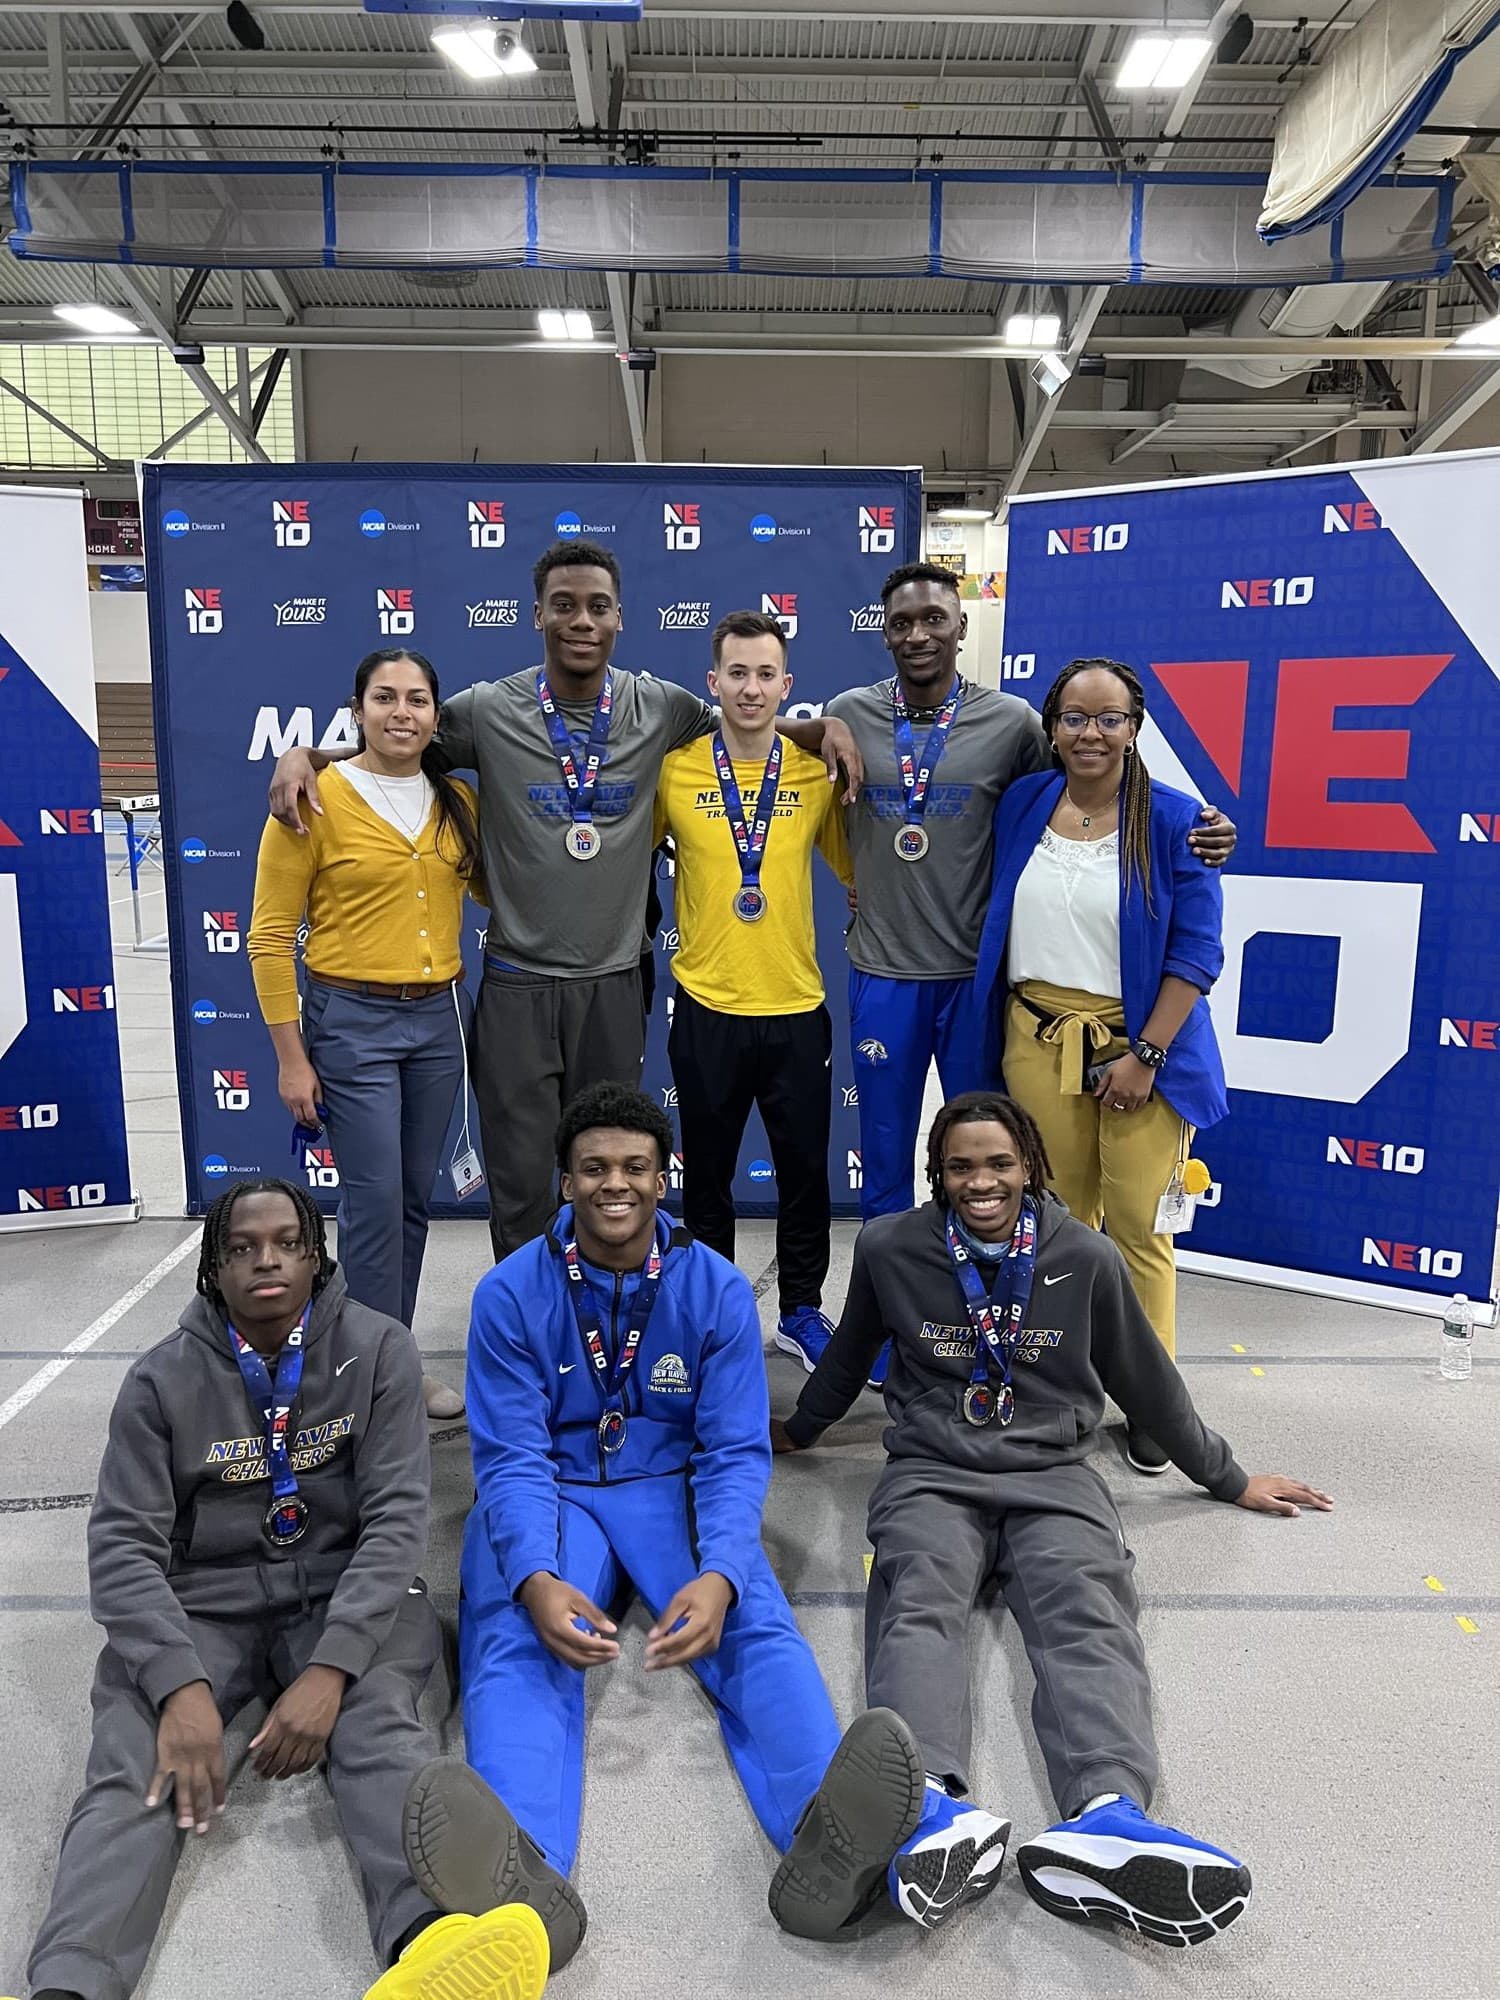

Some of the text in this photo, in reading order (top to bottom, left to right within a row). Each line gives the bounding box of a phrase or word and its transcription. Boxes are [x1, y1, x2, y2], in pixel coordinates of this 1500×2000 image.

[272, 500, 311, 522] NE
[467, 501, 505, 523] NE
[663, 503, 701, 525] NE
[858, 506, 896, 528] NE
[1323, 502, 1390, 534] NE
[166, 522, 190, 531] NCAA
[191, 522, 220, 531] Division
[274, 522, 311, 547] 10
[361, 522, 386, 531] NCAA
[387, 522, 415, 531] Division
[469, 523, 506, 548] 10
[557, 524, 581, 533] NCAA
[583, 524, 611, 533] Division
[664, 525, 701, 550] 10
[752, 526, 776, 536] NCAA
[778, 527, 806, 536] Division
[87, 545, 117, 553] HOME
[859, 528, 895, 553] 10
[1047, 523, 1129, 556] NE10
[184, 588, 222, 609] NE
[293, 598, 327, 606] MAKE IT
[377, 589, 414, 610] NE
[485, 600, 510, 608] MAKE
[1221, 576, 1315, 609] NE10
[273, 600, 326, 627] YOURS
[465, 602, 519, 628] YOURS
[657, 604, 710, 631] YOURS
[677, 602, 711, 610] MAKE IT
[186, 610, 224, 634] 10
[378, 611, 415, 635] 10
[768, 615, 798, 639] 0
[1002, 653, 1036, 681] 10
[539, 681, 555, 714] NE10
[247, 706, 359, 761] MA
[561, 755, 579, 789] NE10
[583, 755, 600, 788] NE10
[717, 750, 732, 780] NE10
[901, 754, 915, 788] NE10
[696, 789, 800, 805] NE HEN
[913, 768, 930, 801] NE10
[40, 808, 103, 835] NE1
[773, 808, 793, 818] ELD
[733, 821, 749, 853] NE10
[751, 820, 767, 852] NE10
[183, 849, 207, 858] NCAA
[208, 850, 236, 858] Division
[203, 911, 239, 930] NE
[205, 931, 240, 953] 10
[53, 985, 115, 1013] NE1
[1206, 873, 1424, 1105] 0
[193, 1010, 217, 1019] NCAA
[218, 1011, 245, 1019] Division
[1439, 1018, 1500, 1051] NE
[213, 1069, 249, 1088] NE
[214, 1089, 250, 1110] 10
[0, 1103, 58, 1131] E10
[305, 1148, 336, 1167] NE
[1326, 1135, 1425, 1175] NE10
[205, 1165, 228, 1173] NCAA
[229, 1165, 256, 1173] Division
[306, 1167, 340, 1188] 10
[750, 1169, 772, 1177] NCAA
[18, 1183, 106, 1211] NE10
[565, 1242, 582, 1281] NE10
[1362, 1236, 1463, 1279] NE10
[977, 1307, 1000, 1346] NE10
[586, 1329, 608, 1370] NE10
[620, 1330, 641, 1369] NE10
[206, 1436, 266, 1463] NEW
